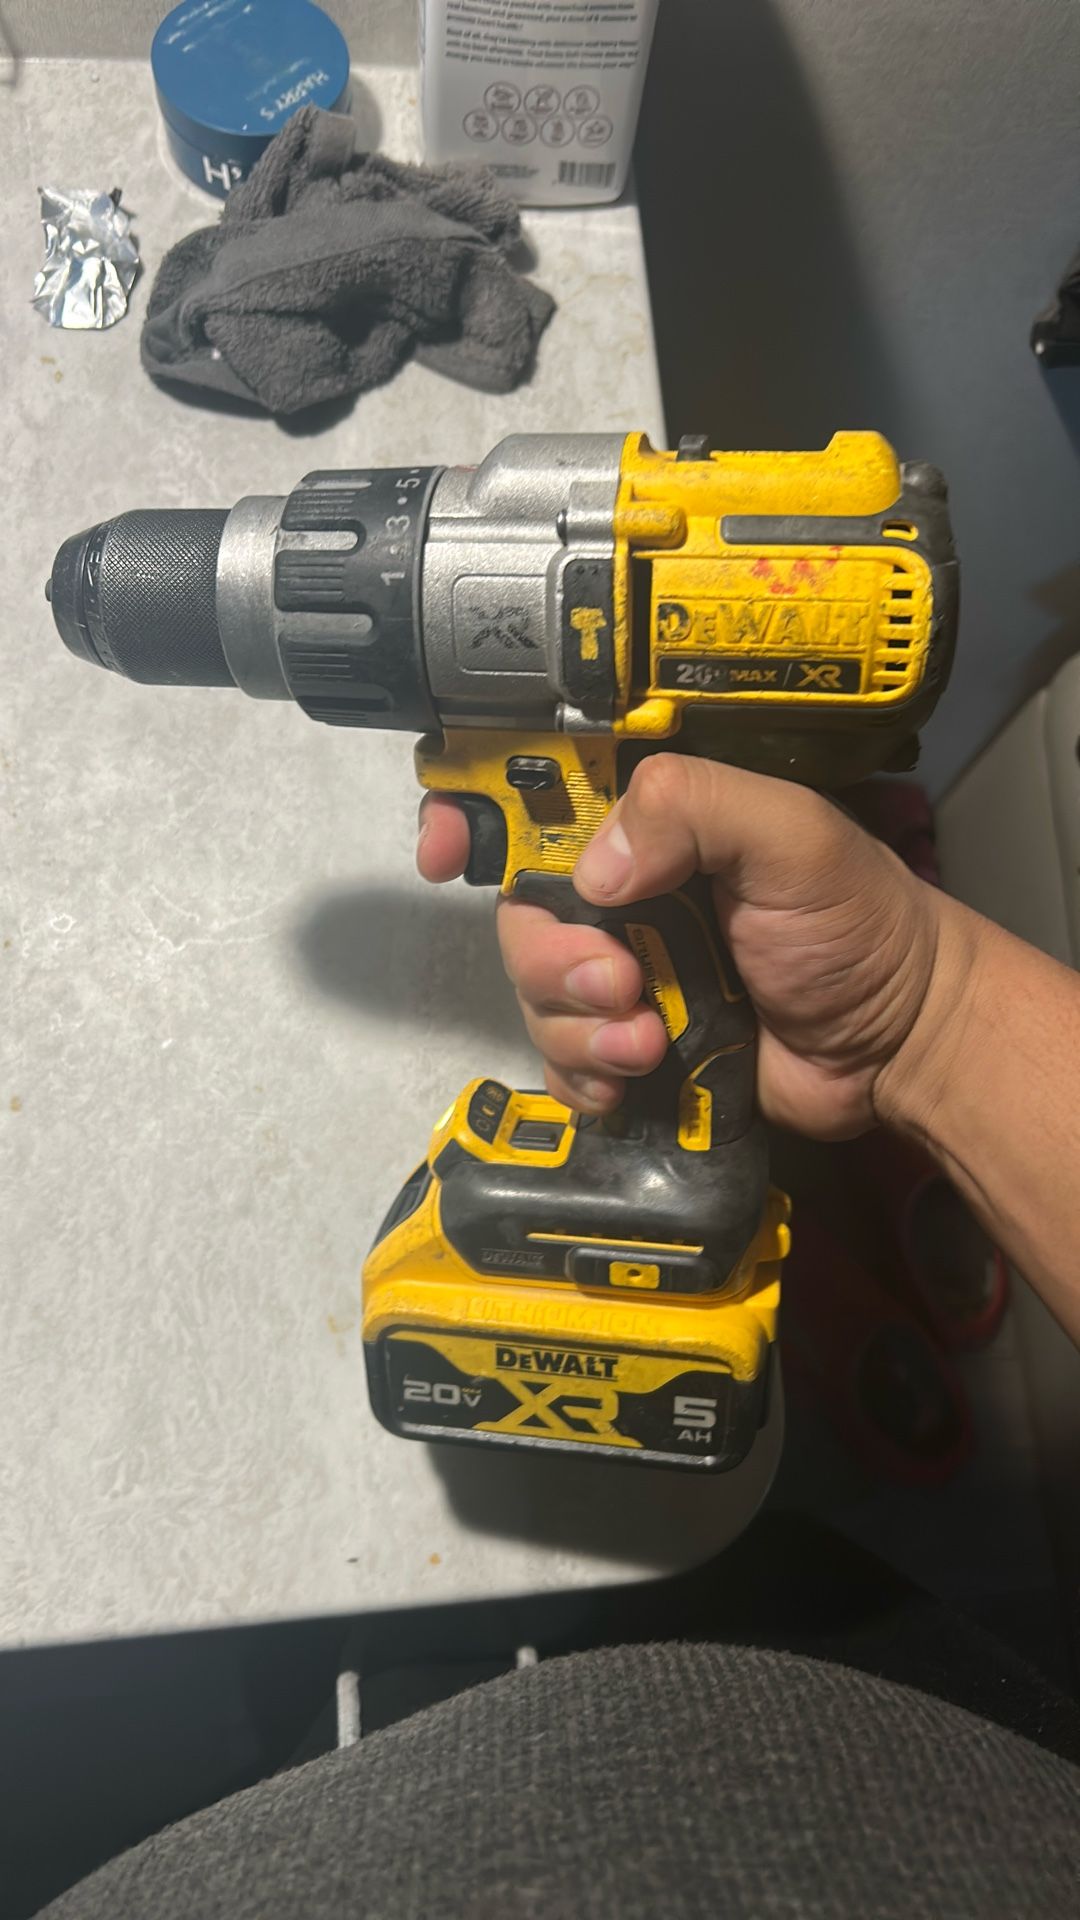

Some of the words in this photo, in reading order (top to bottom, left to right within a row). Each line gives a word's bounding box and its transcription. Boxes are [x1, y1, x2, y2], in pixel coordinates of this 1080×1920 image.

[395, 477, 421, 489] 5
[386, 515, 410, 533] 3
[380, 571, 405, 586] 1
[730, 668, 778, 684] MAX
[794, 663, 842, 688] XR
[495, 1346, 619, 1379] DEWALT
[472, 1377, 644, 1448] XR
[673, 1396, 717, 1429] 5
[678, 1428, 711, 1444] AH
